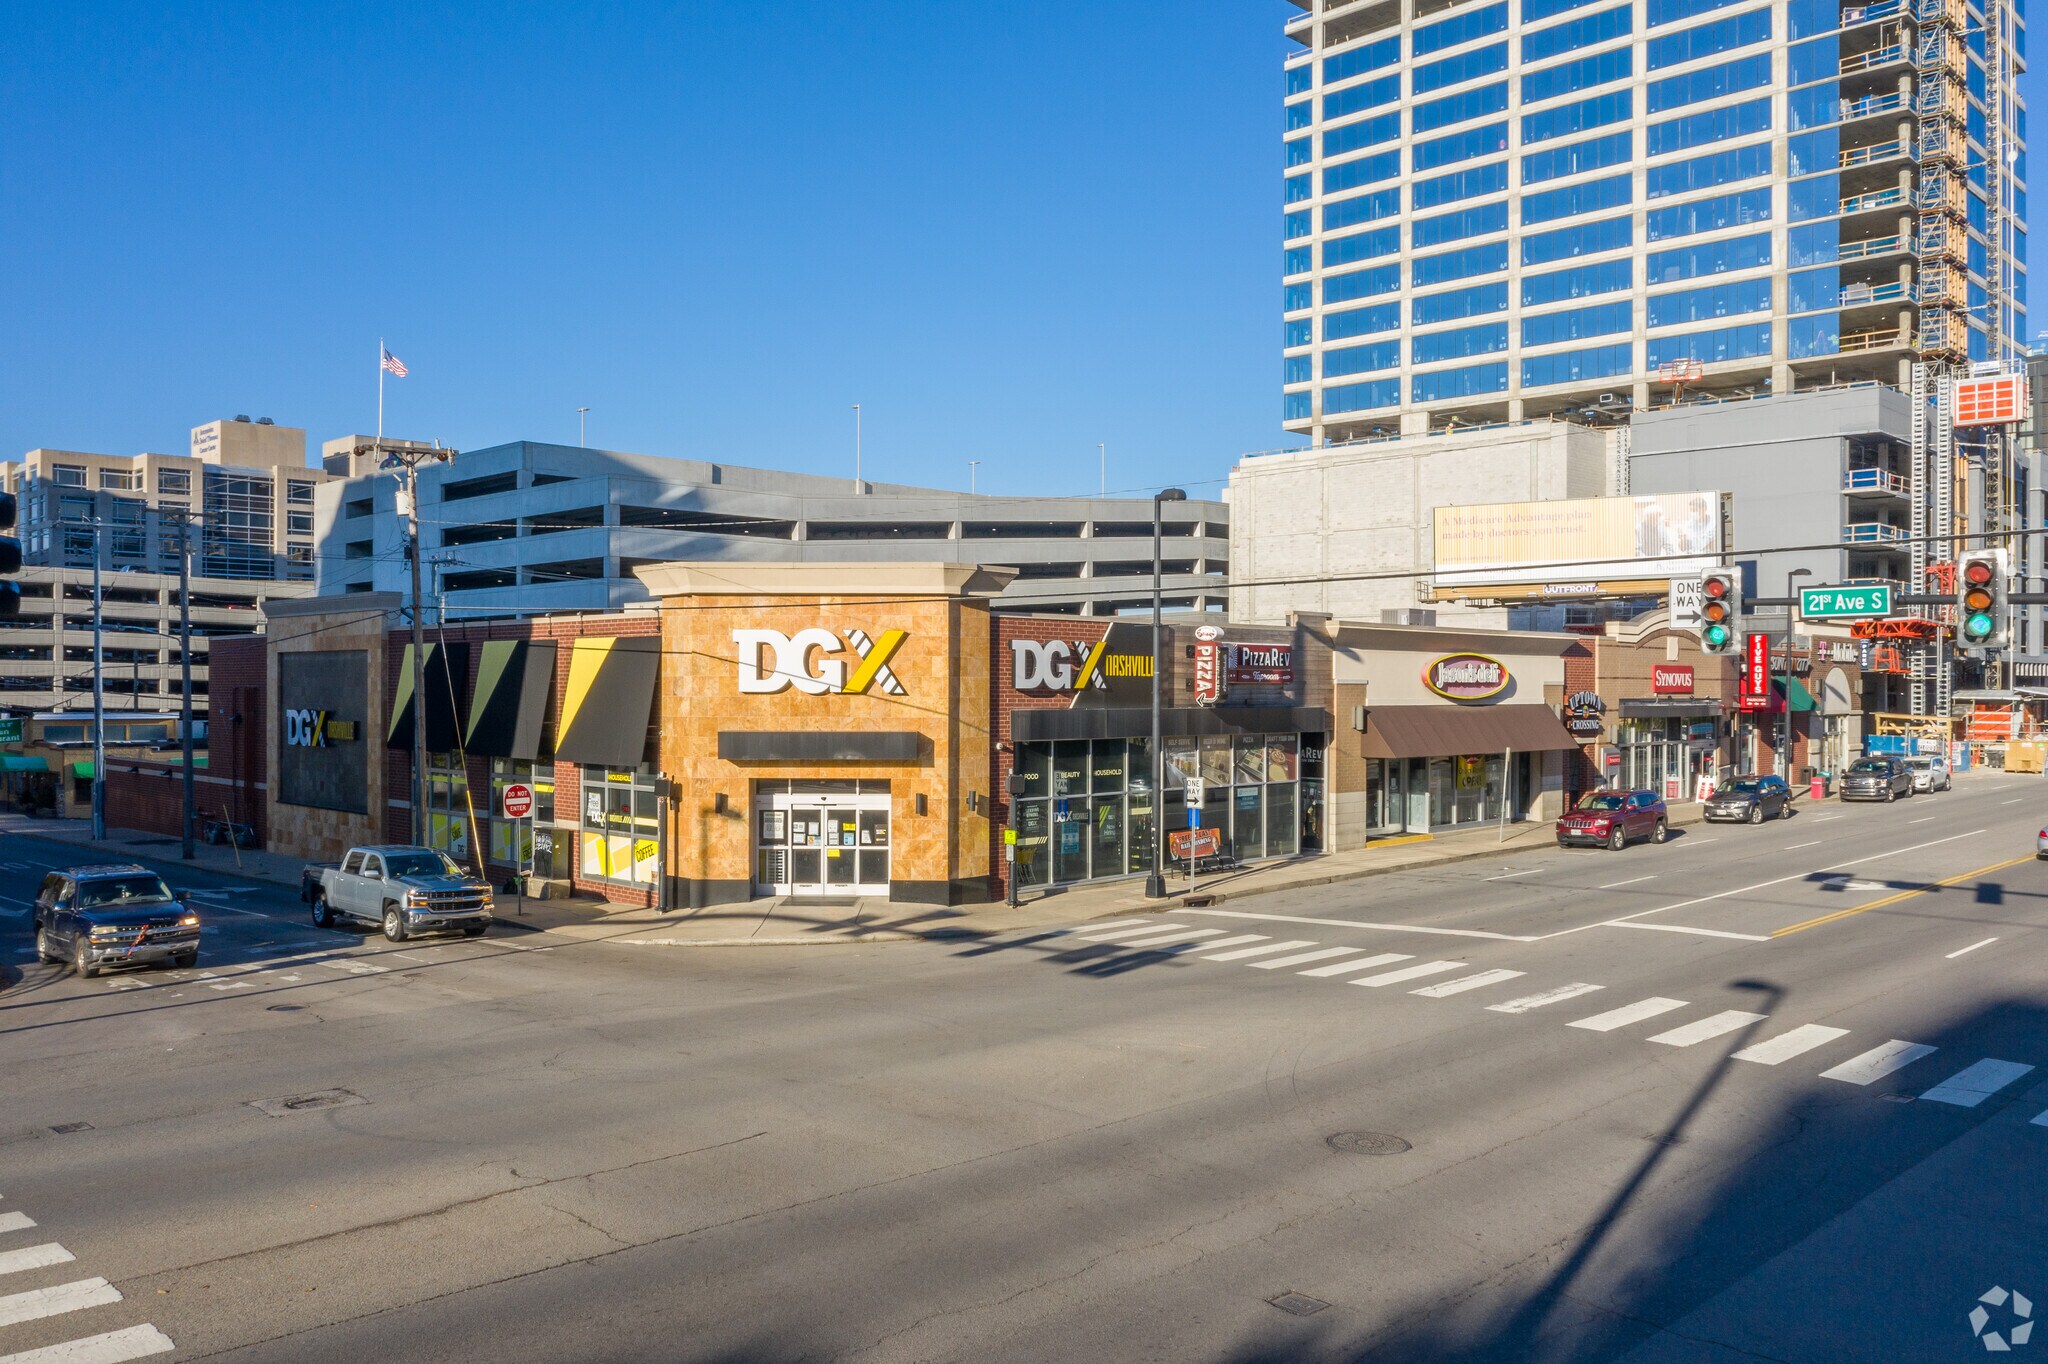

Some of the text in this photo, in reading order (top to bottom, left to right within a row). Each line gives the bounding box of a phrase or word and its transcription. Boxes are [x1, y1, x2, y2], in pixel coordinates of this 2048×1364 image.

[1545, 585, 1596, 594] OUTFRONT
[1677, 582, 1702, 594] ONE
[1676, 595, 1702, 607] WAY
[1835, 593, 1865, 611] Ave
[1871, 591, 1882, 609] S
[732, 628, 906, 695] DGX
[1012, 639, 1107, 690] DGX
[1754, 635, 1763, 694] FIVE GUYS
[1197, 645, 1213, 692] PIZZA
[1252, 670, 1280, 682] Taproom
[1436, 661, 1501, 689] Jason's deli
[1655, 669, 1692, 687] SYNOVUS
[1568, 690, 1602, 712] UPTOWN
[286, 708, 326, 748] DGX
[1571, 719, 1600, 731] CROSSING
[608, 773, 632, 783] HOUSEHOL
[1060, 771, 1081, 779] BEAUTY
[1093, 769, 1123, 777] HOUSEHOLD
[1187, 779, 1200, 788] ONE
[509, 804, 527, 812] ENTER
[1053, 811, 1073, 823] DGX
[635, 843, 655, 863] COFFEE
